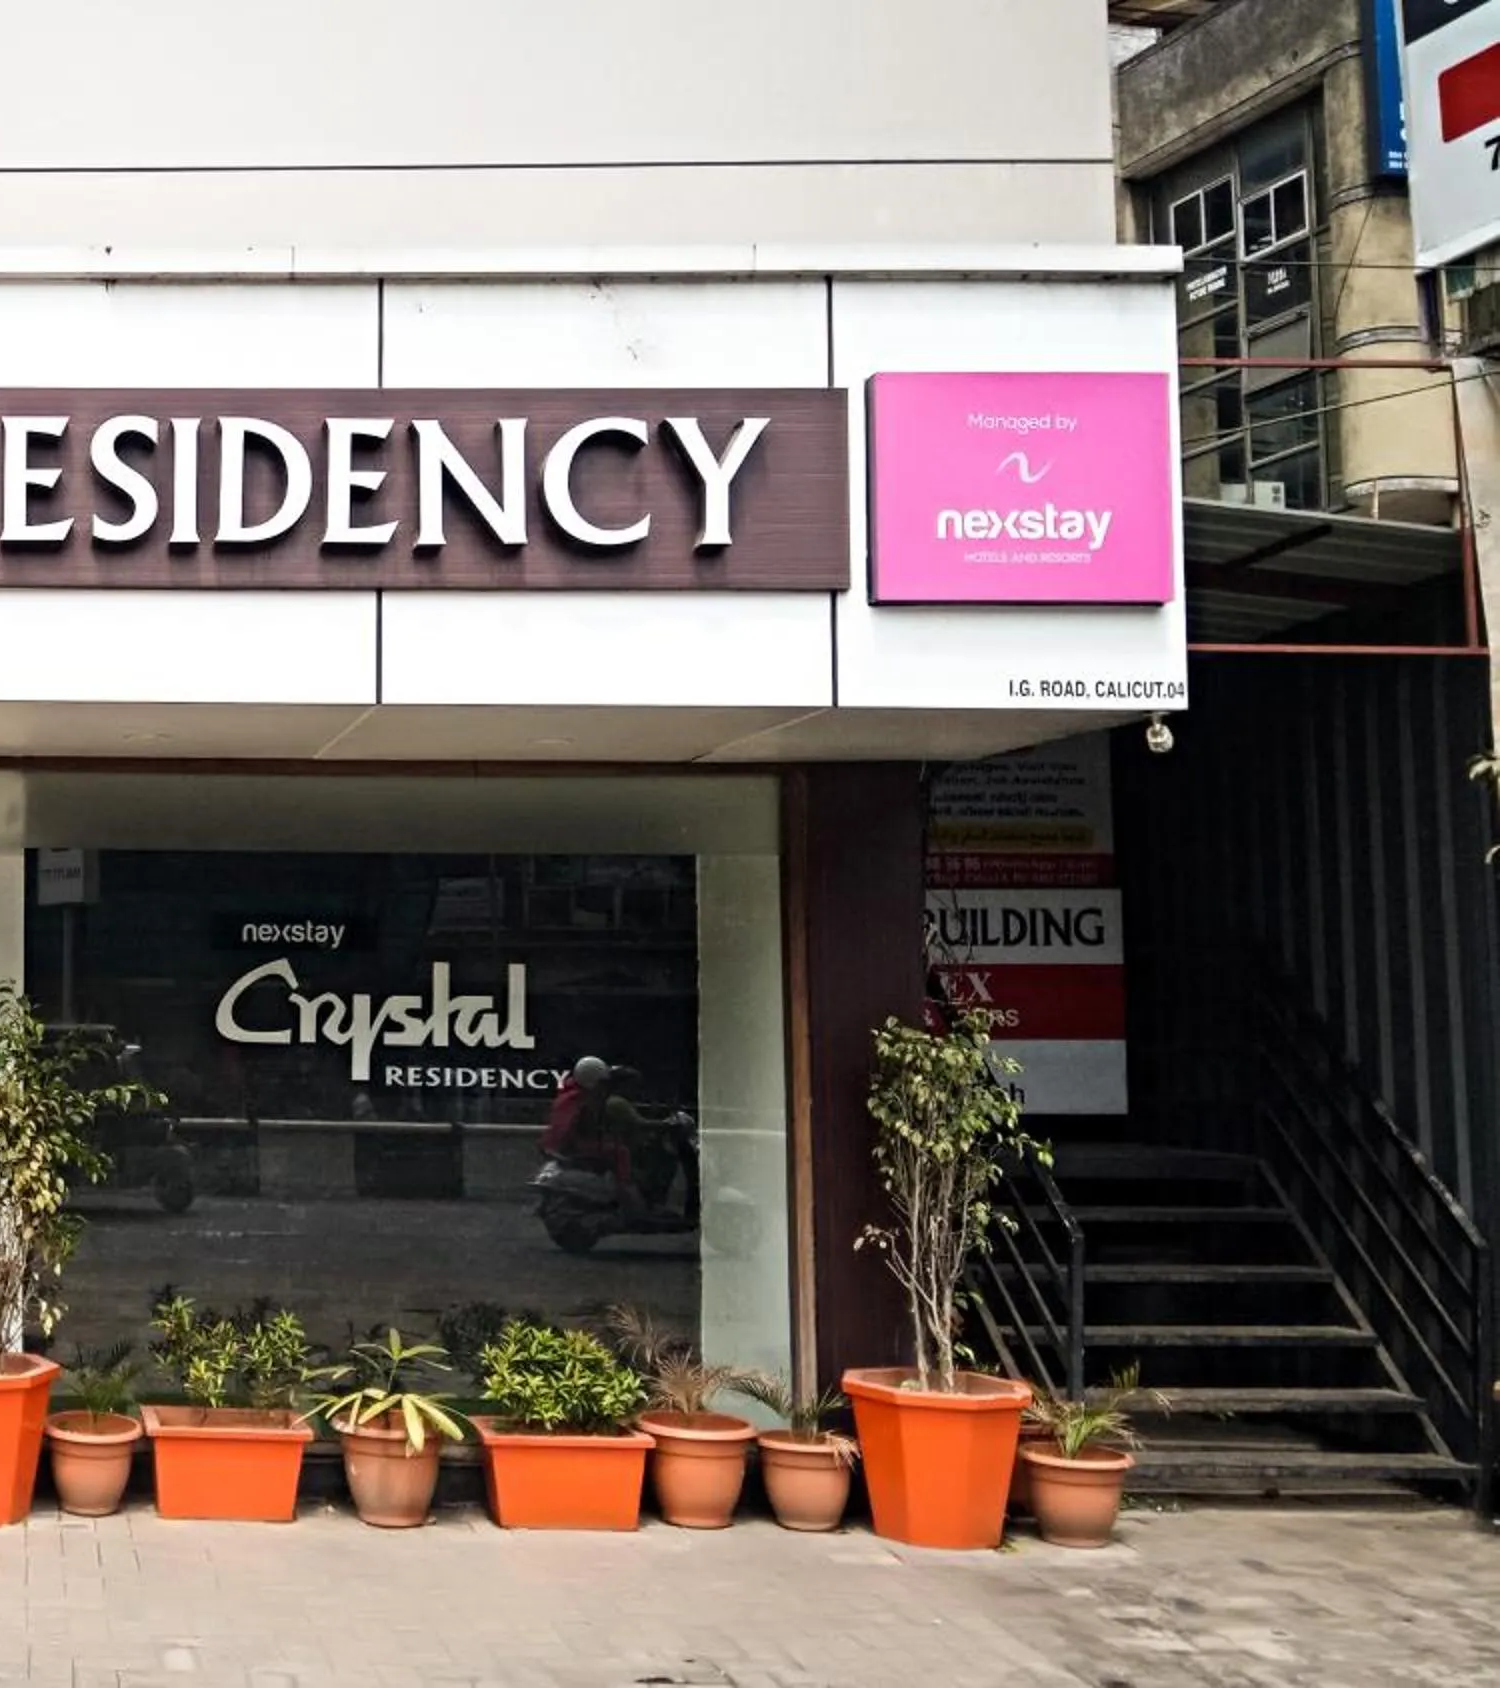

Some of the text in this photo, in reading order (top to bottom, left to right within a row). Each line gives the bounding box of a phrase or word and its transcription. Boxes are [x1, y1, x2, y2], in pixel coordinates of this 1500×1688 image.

[968, 413, 1078, 435] Managed by
[937, 502, 1113, 551] nexstay
[1008, 679, 1035, 697] I.G.
[242, 922, 346, 949] nexstay
[215, 957, 535, 1081] Crystal
[385, 1065, 572, 1089] RESIDENCY
